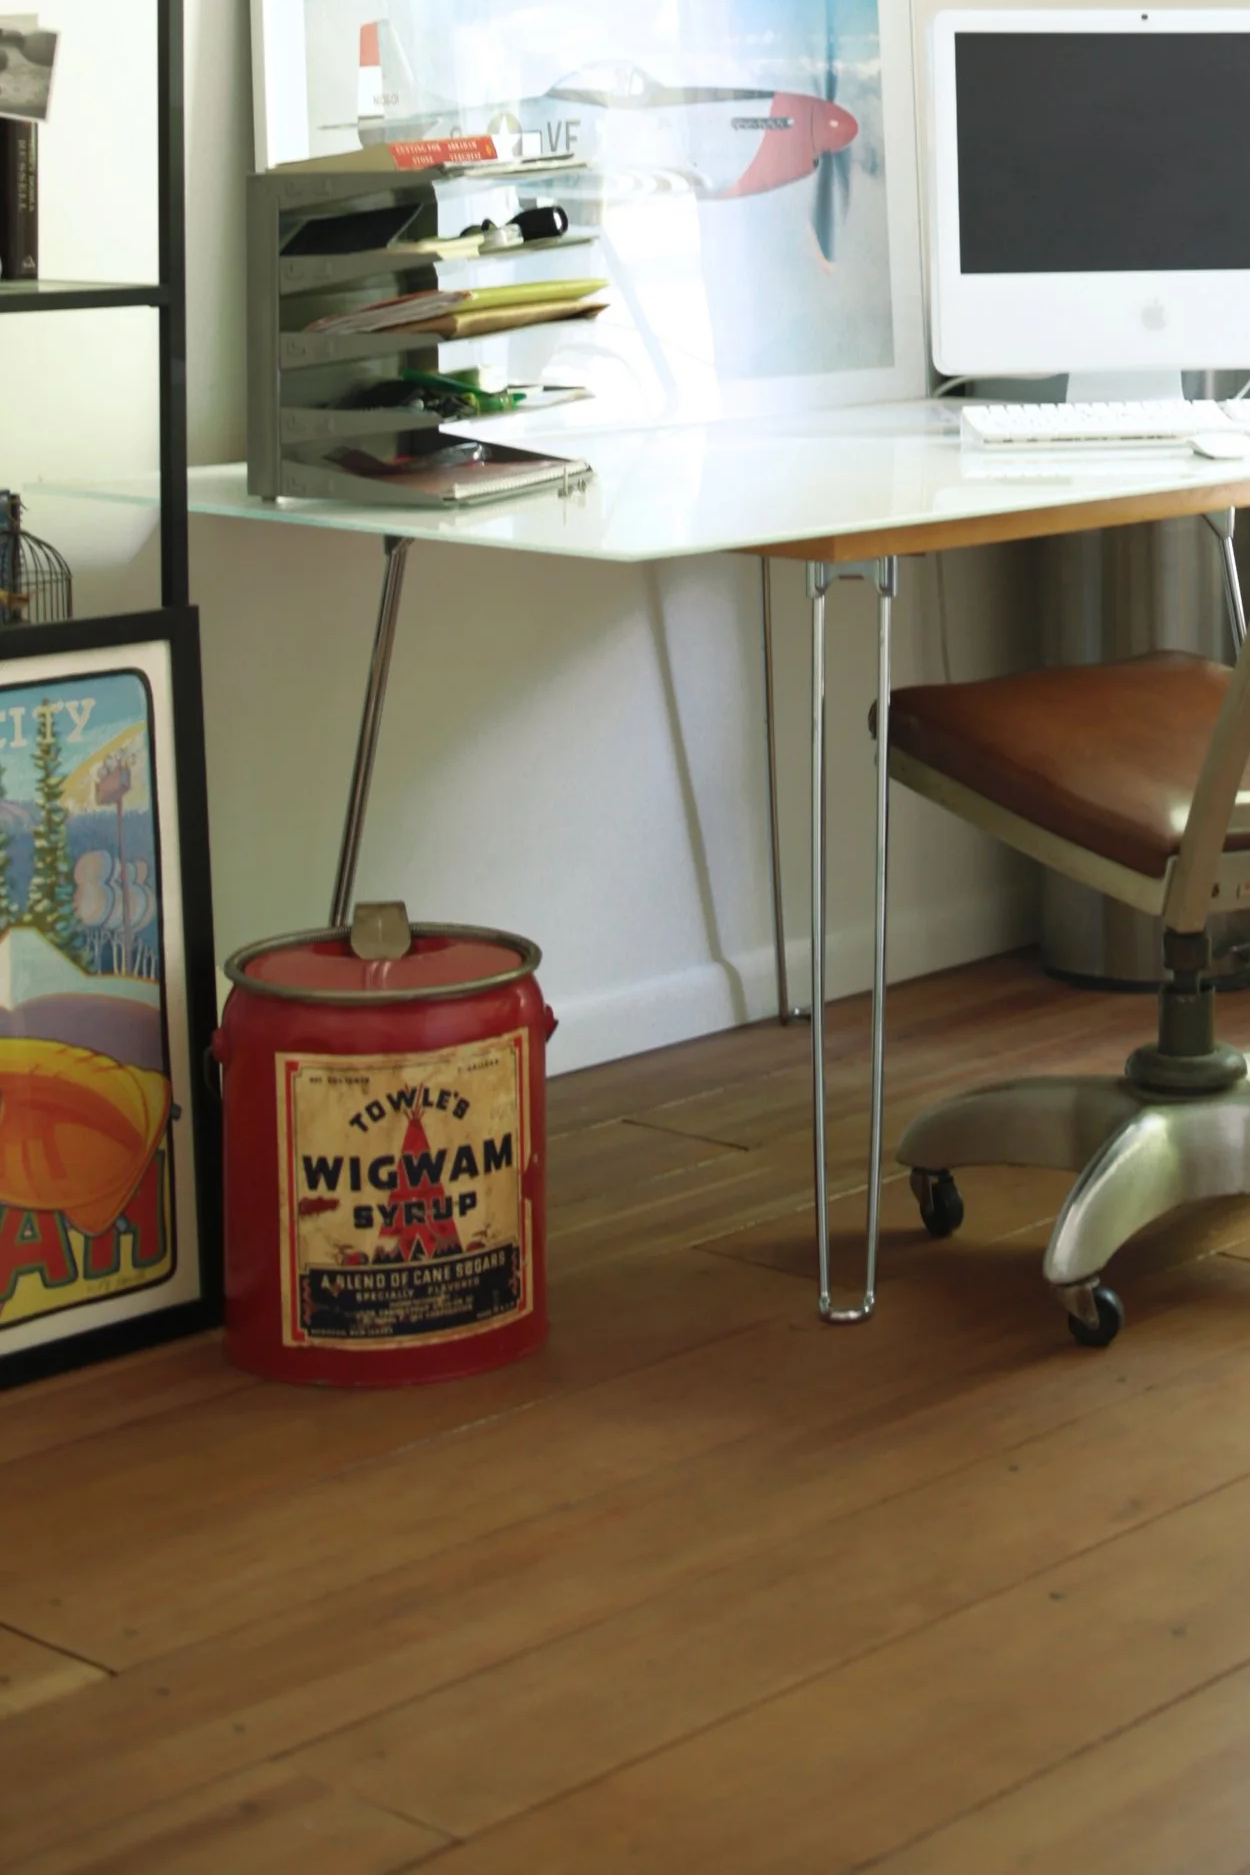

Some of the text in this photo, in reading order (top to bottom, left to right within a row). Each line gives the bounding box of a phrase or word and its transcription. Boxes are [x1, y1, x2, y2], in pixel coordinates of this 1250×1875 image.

[547, 119, 581, 153] VF
[349, 1087, 470, 1133] TOWLE'S
[302, 1132, 513, 1192] WIGWAM
[353, 1190, 477, 1229] SYRUP
[321, 1251, 506, 1290] A BLEND OF CANE SUGARS
[356, 1289, 415, 1302] SPECIALLY
